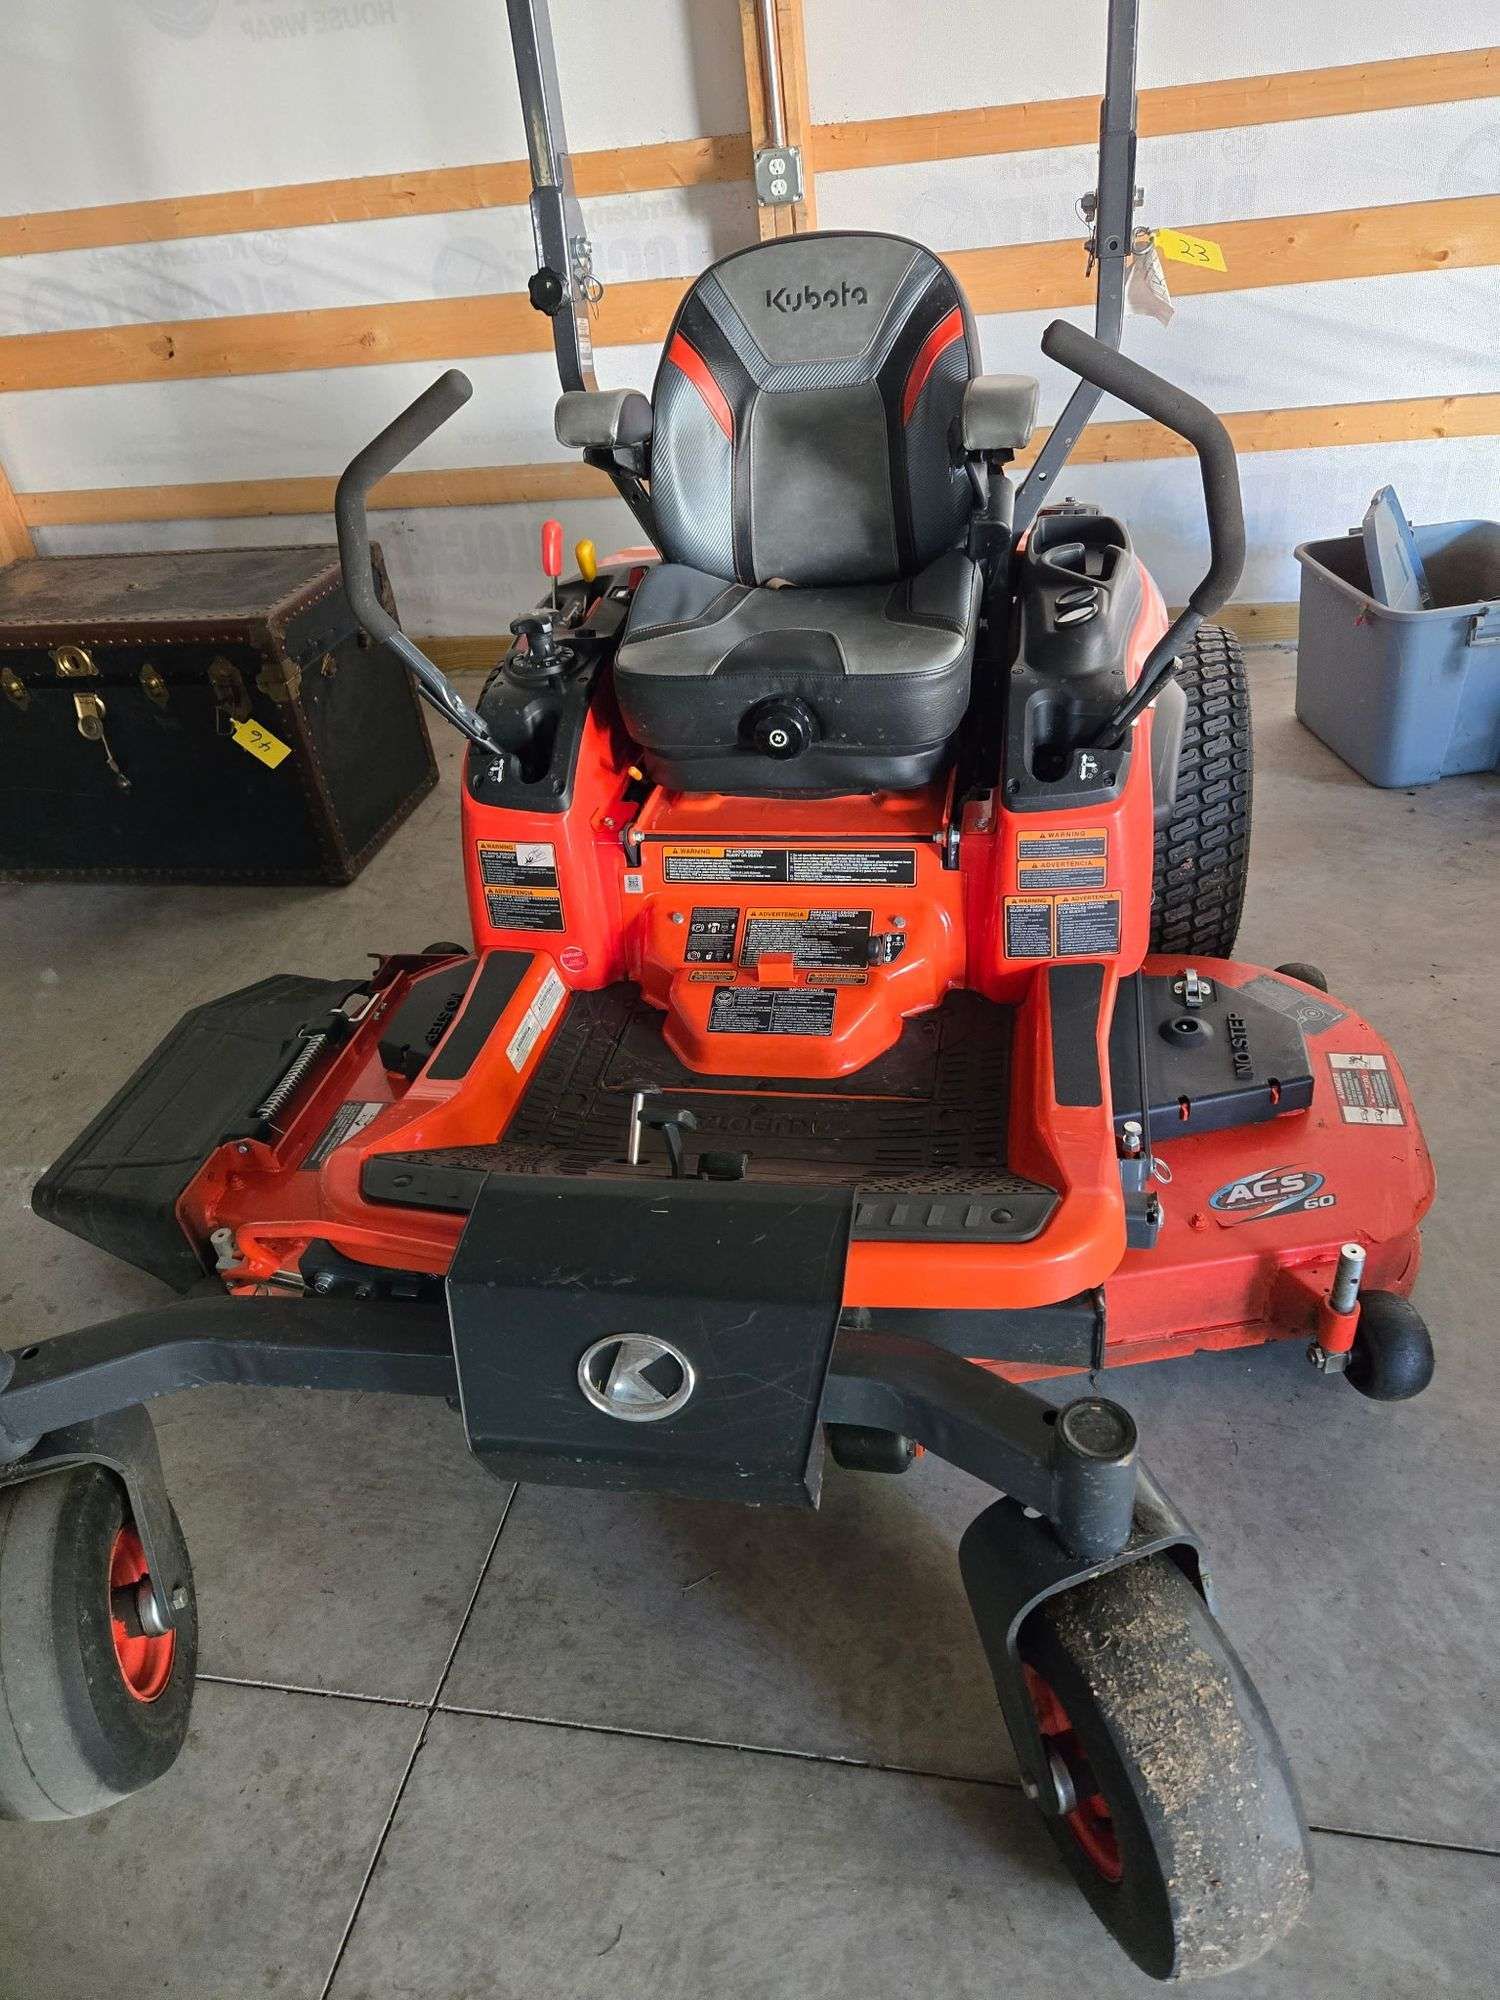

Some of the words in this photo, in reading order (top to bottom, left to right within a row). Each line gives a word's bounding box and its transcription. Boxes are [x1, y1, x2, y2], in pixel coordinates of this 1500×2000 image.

[1180, 239, 1210, 262] 23
[766, 280, 868, 313] Kubota
[1048, 830, 1086, 838] WARNING
[680, 847, 711, 855] WARNING
[1041, 860, 1094, 868] ADVERTENCIA
[1071, 894, 1113, 902] ADVERTENCIA
[1228, 1011, 1249, 1048] STEP
[1235, 1051, 1253, 1074] NO
[1226, 1173, 1306, 1204] ACS
[1303, 1195, 1335, 1209] 60
